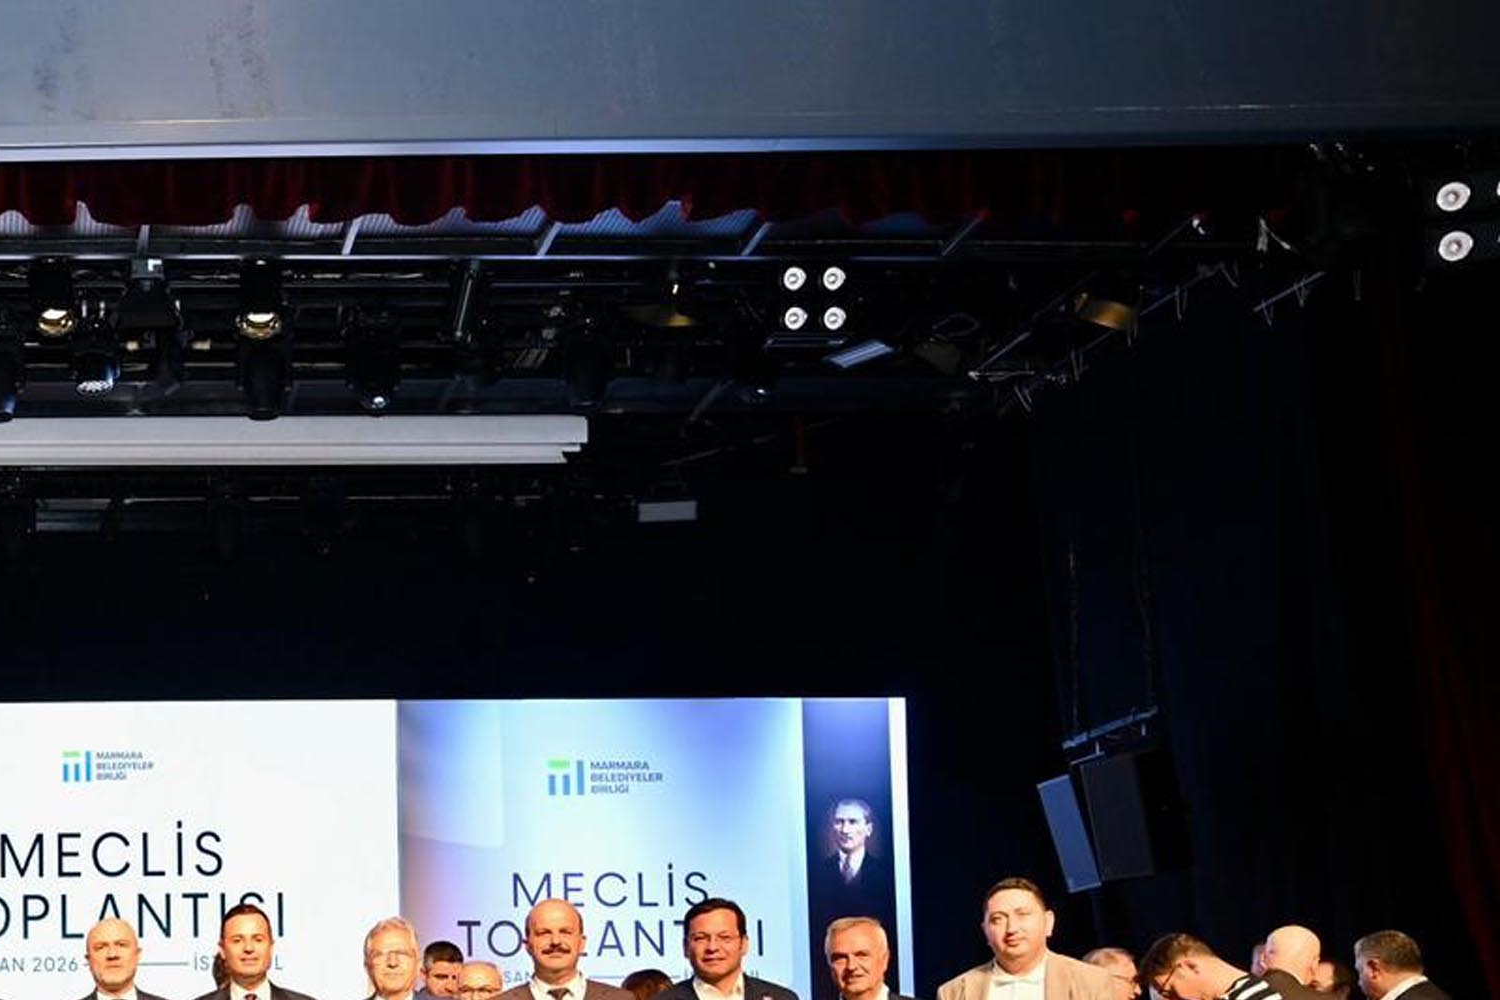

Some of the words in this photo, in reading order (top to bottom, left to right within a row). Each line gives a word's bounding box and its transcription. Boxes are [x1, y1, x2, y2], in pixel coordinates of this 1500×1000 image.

[0, 820, 224, 879] MECLİS
[512, 863, 710, 908] MECLİS
[33, 956, 78, 973] 2026
